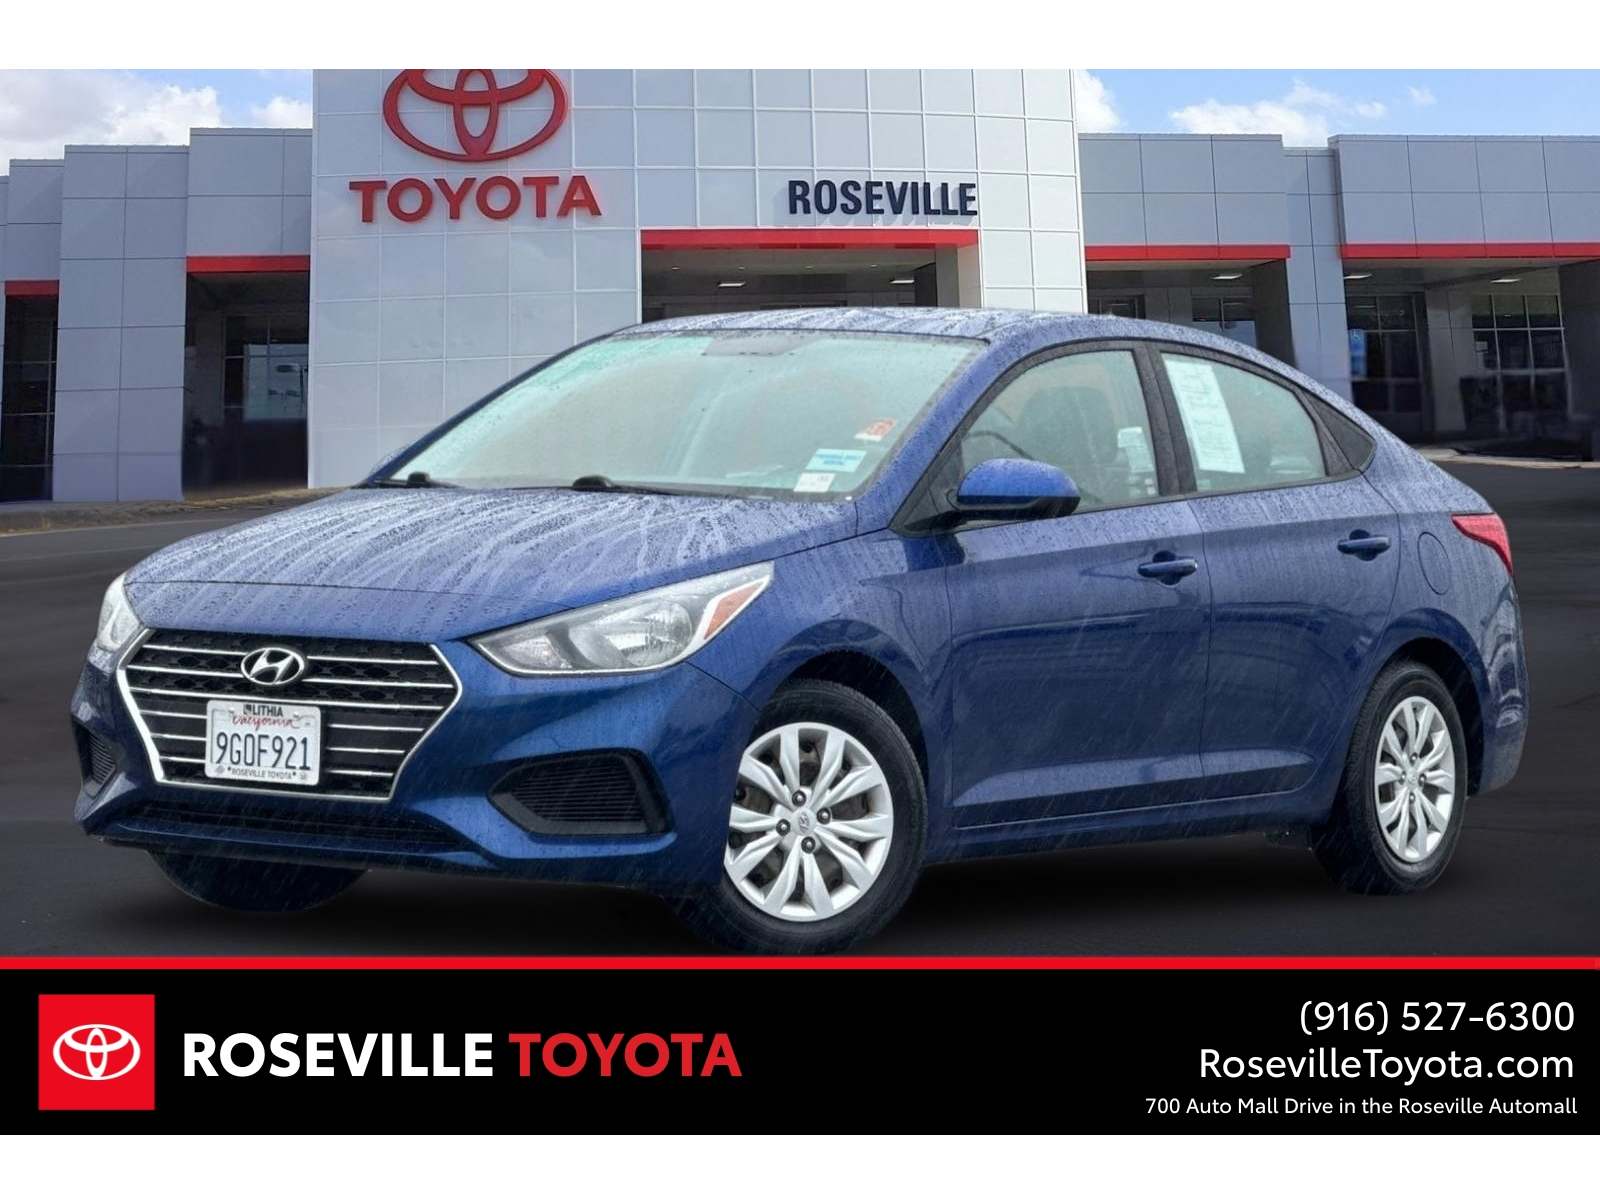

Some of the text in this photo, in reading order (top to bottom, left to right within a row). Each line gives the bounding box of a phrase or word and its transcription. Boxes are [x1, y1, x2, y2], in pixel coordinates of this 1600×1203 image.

[349, 176, 602, 223] TOYOTA
[788, 179, 978, 217] ROSEVILLE
[252, 703, 284, 717] LITHIA
[231, 767, 292, 780] ROSEVILLE TOYOTA
